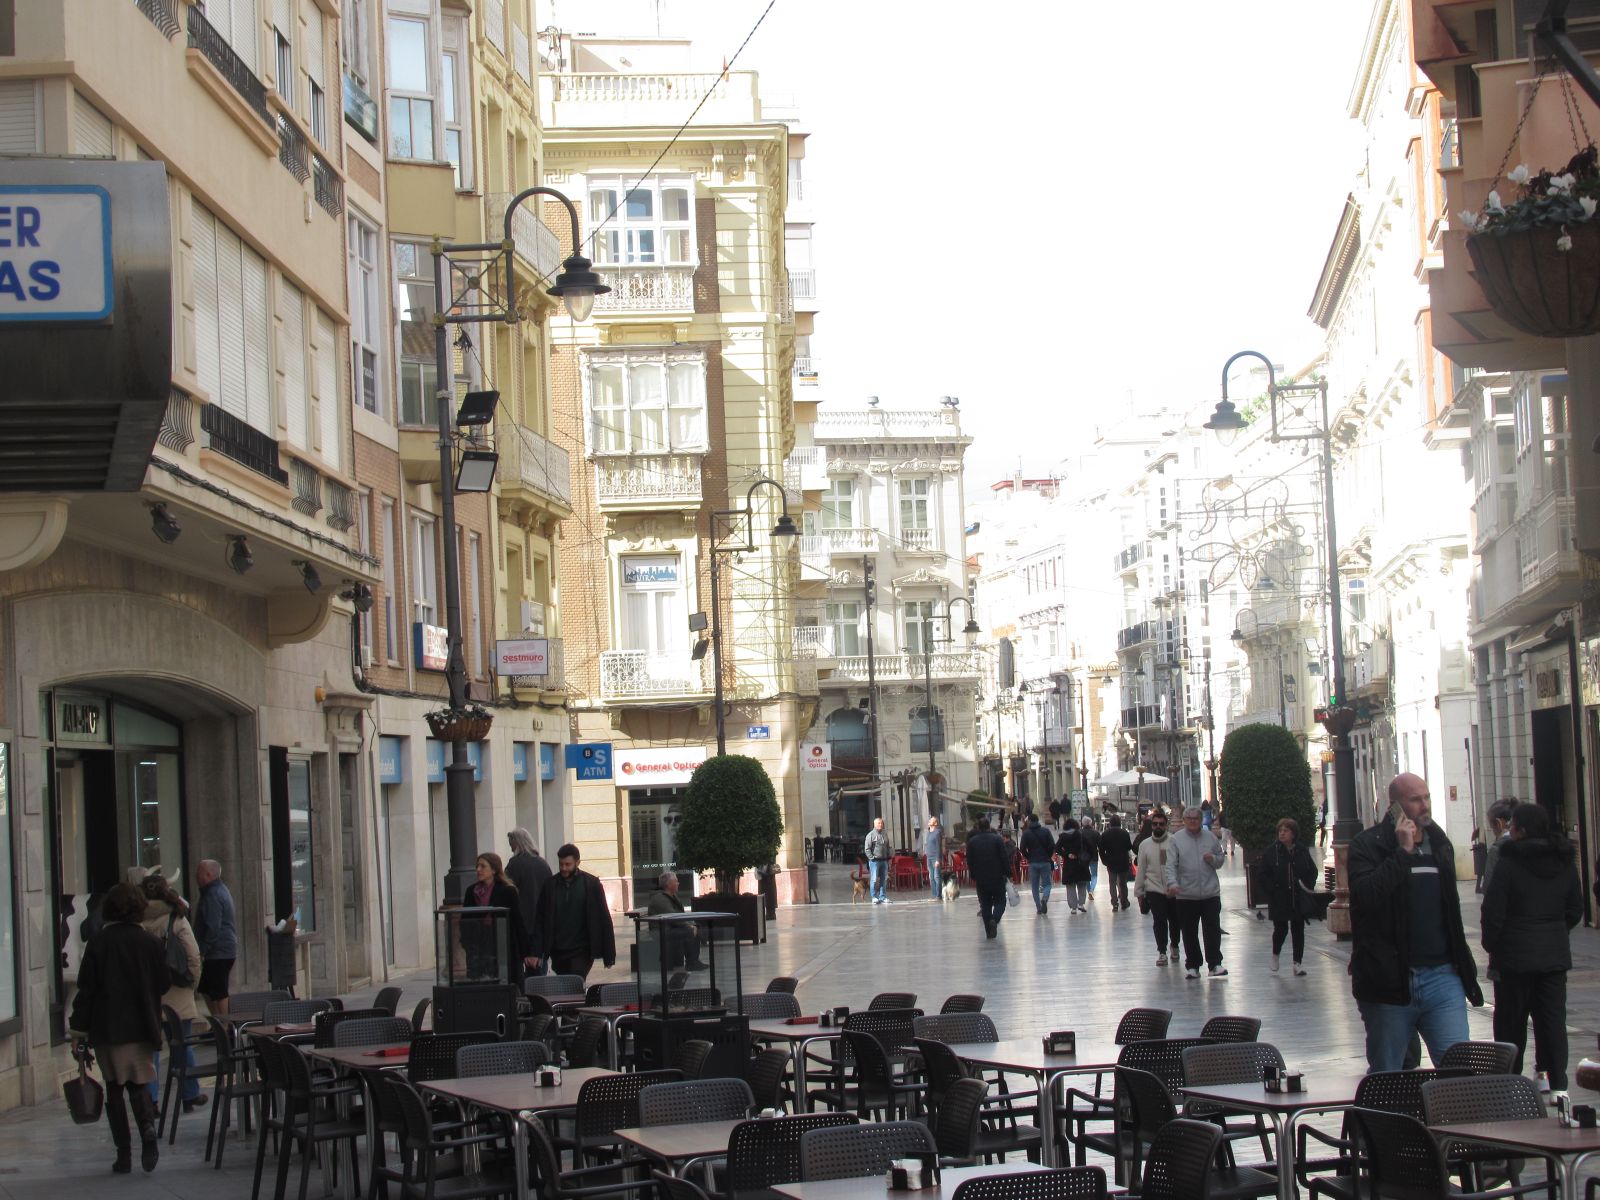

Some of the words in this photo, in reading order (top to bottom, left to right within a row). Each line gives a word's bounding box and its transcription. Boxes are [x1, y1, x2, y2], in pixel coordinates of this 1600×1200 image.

[502, 654, 544, 664] gestmuro
[594, 749, 607, 765] S
[583, 766, 607, 777] ATM
[635, 761, 671, 772] General
